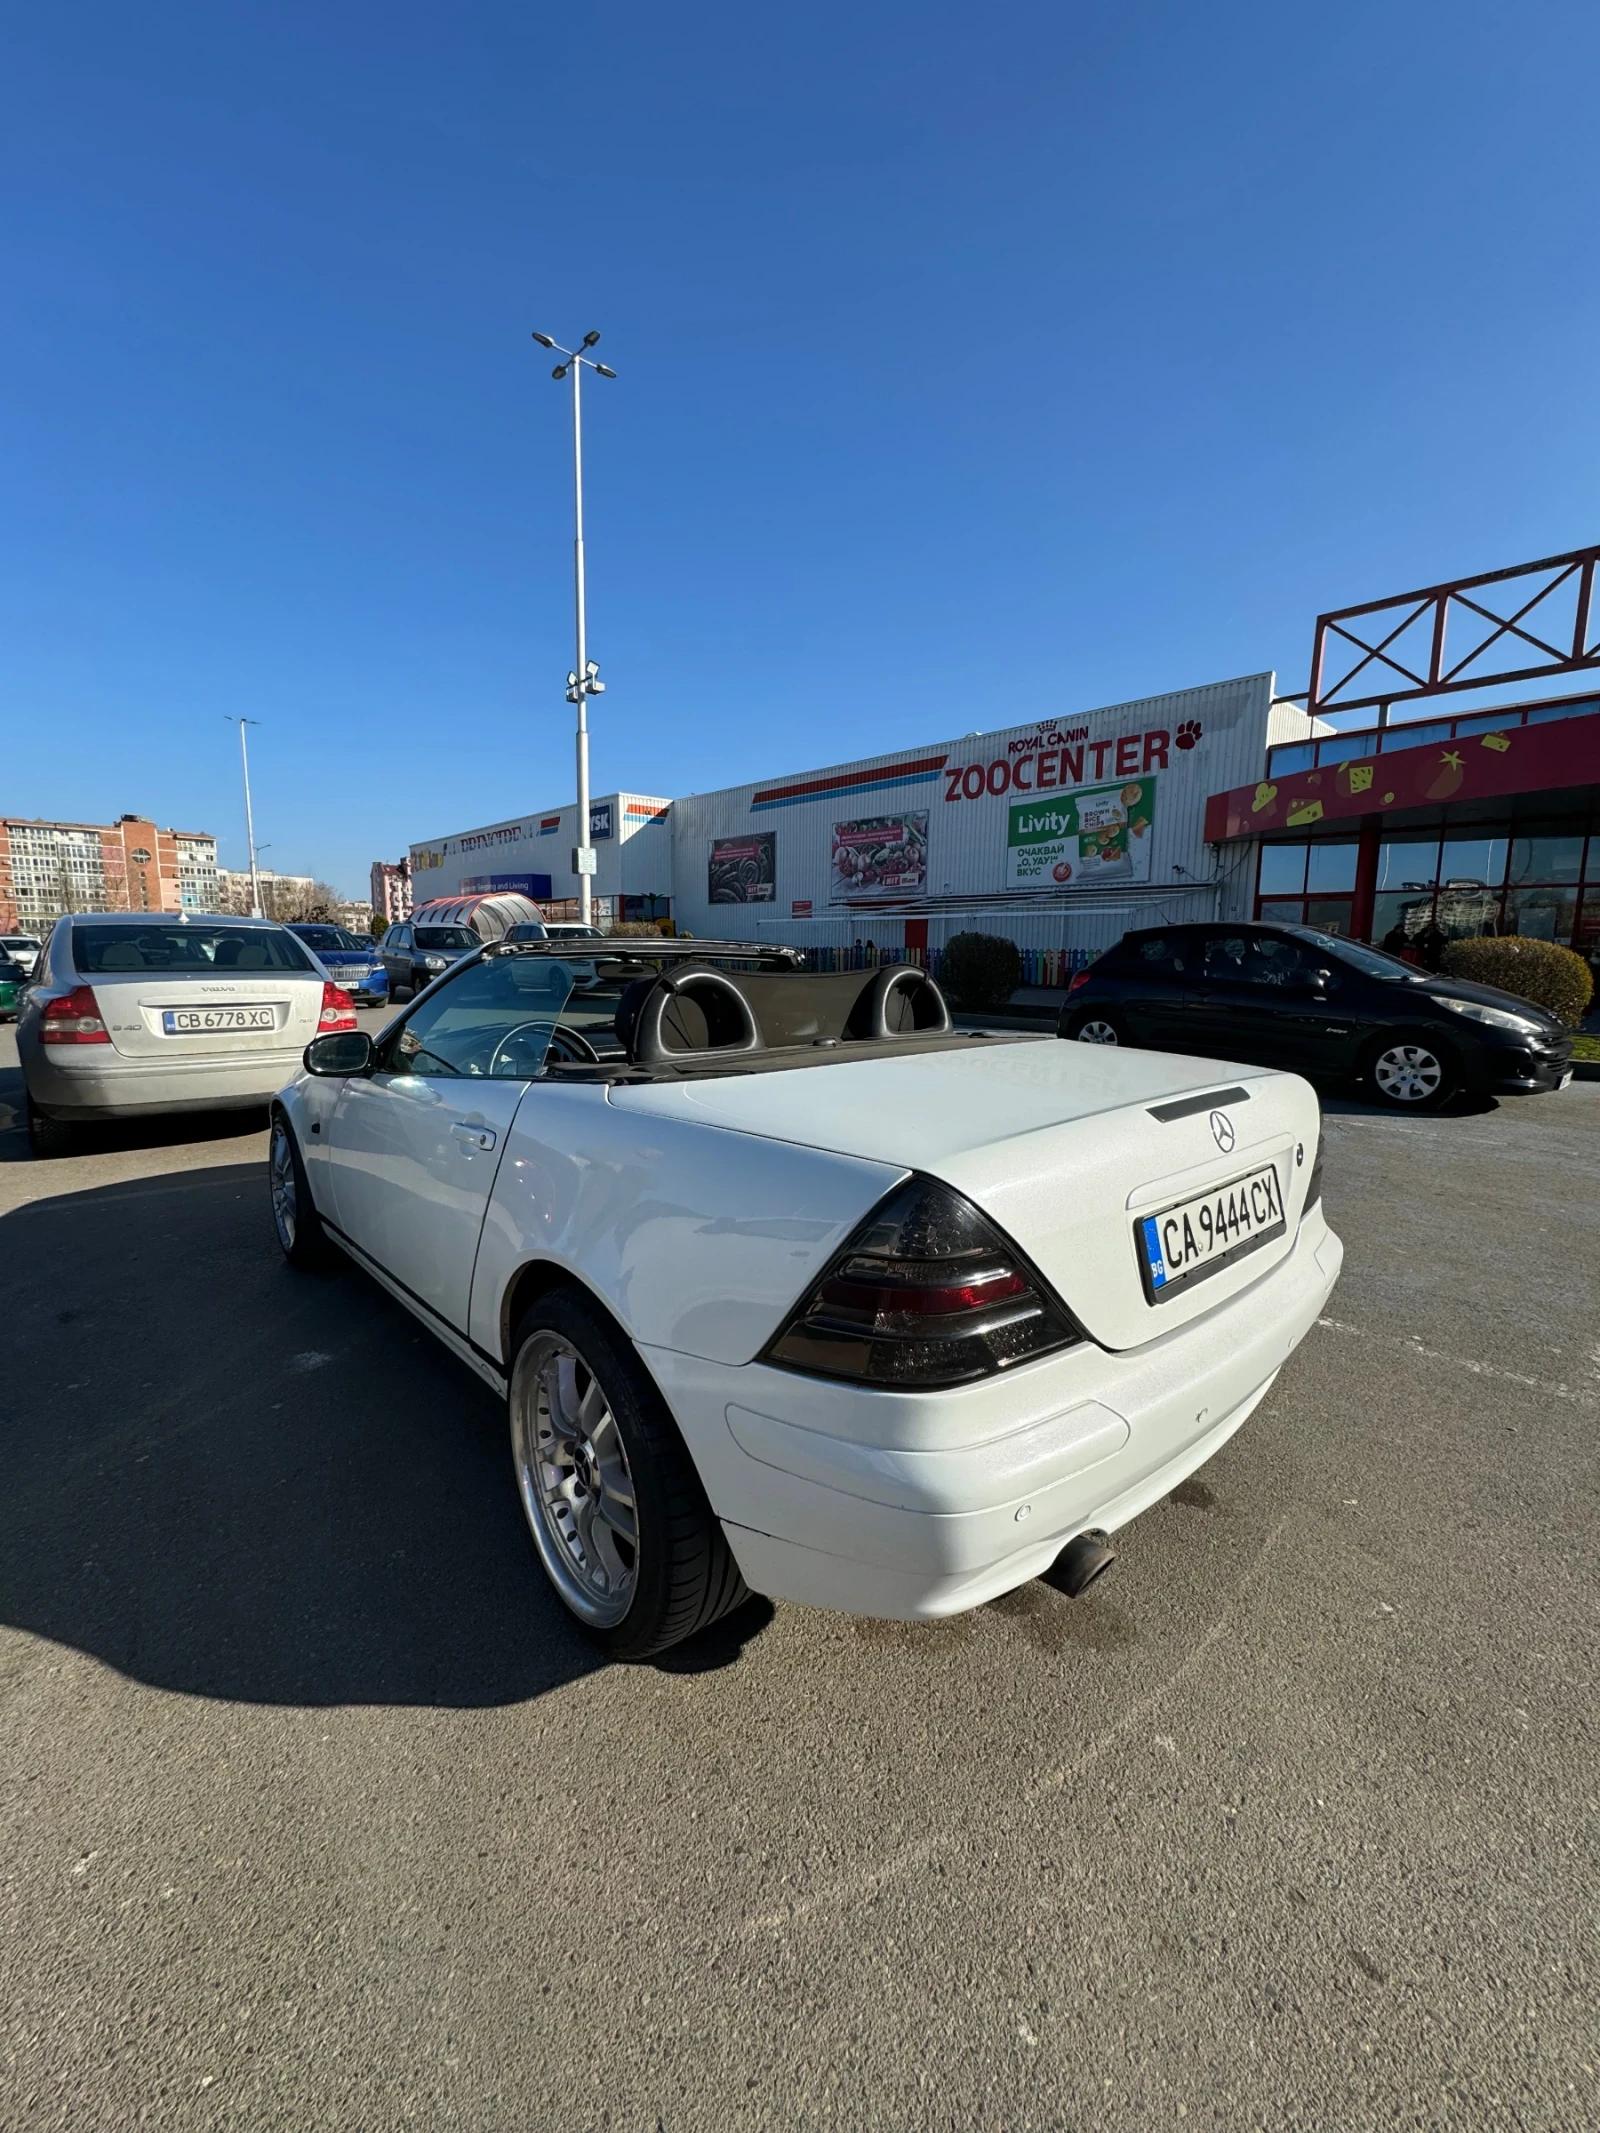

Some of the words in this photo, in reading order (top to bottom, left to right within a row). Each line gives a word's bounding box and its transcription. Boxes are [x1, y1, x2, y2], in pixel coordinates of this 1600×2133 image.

[1008, 738, 1045, 754] ROYAL
[1047, 725, 1089, 746] CANIN
[945, 730, 1170, 802] ZOOCENTER
[1084, 808, 1110, 818] BROWN
[589, 813, 609, 831] YSK
[1019, 812, 1071, 836] Livity
[1017, 843, 1065, 857] ОЧАКВАЙ
[1017, 867, 1041, 877] ВКУС
[497, 882, 508, 890] and
[509, 881, 529, 891] Living
[177, 1013, 201, 1028] CB
[204, 1012, 246, 1027] 6778
[248, 1011, 270, 1025] XC
[1151, 1260, 1163, 1278] BG
[1163, 1212, 1199, 1269] CA
[1199, 1187, 1251, 1252] 9444
[1251, 1175, 1278, 1224] CX
